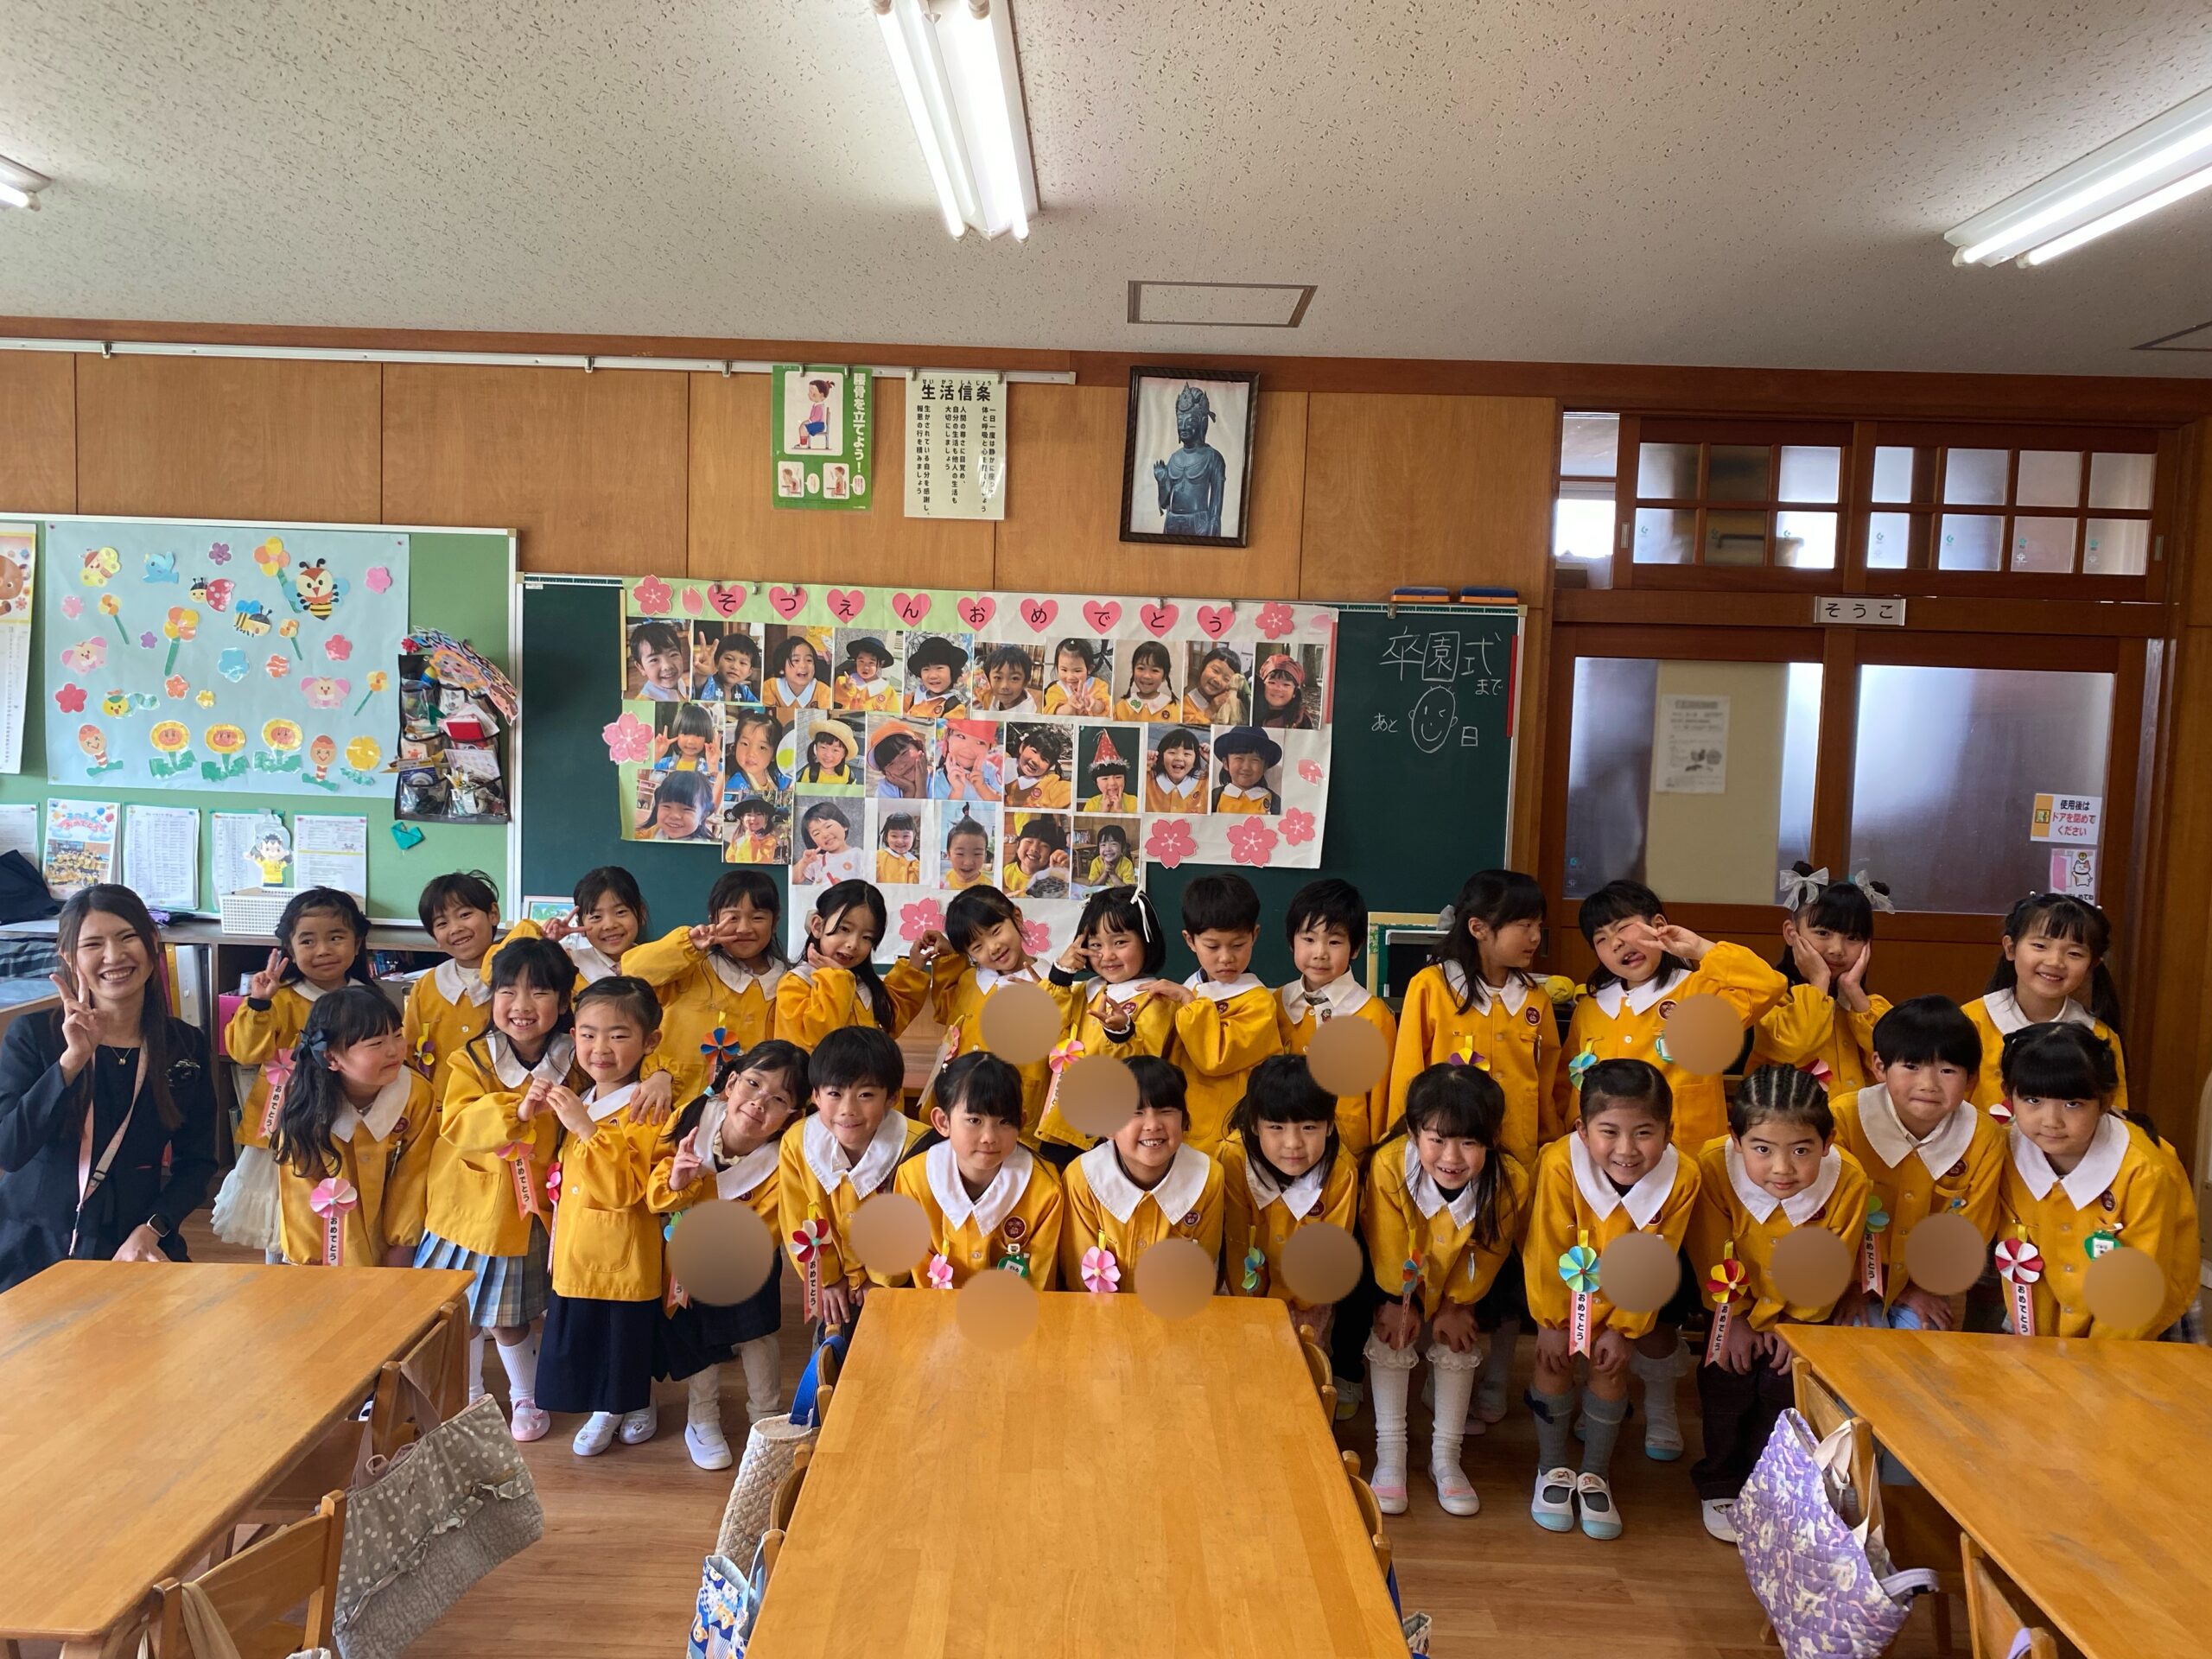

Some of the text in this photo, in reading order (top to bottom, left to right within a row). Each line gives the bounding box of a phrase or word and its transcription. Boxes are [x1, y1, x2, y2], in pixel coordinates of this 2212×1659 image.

[921, 384, 991, 402] 生活信条
[1825, 602, 1893, 619] そうこ
[1379, 625, 1503, 683] 卒園式
[1475, 679, 1503, 696] まで
[1371, 713, 1478, 747] あと 日
[2060, 799, 2090, 811] 使用後は
[2057, 826, 2088, 836] ください
[266, 1085, 282, 1127] おめでとう
[516, 1158, 530, 1202] おめでとう
[329, 1217, 338, 1261] おめでとう
[1866, 1233, 1875, 1279] おめでとう
[1577, 1294, 1586, 1340] おめでとう
[1714, 1306, 1728, 1351] おめでとう
[2018, 1286, 2028, 1332] おめでとう
